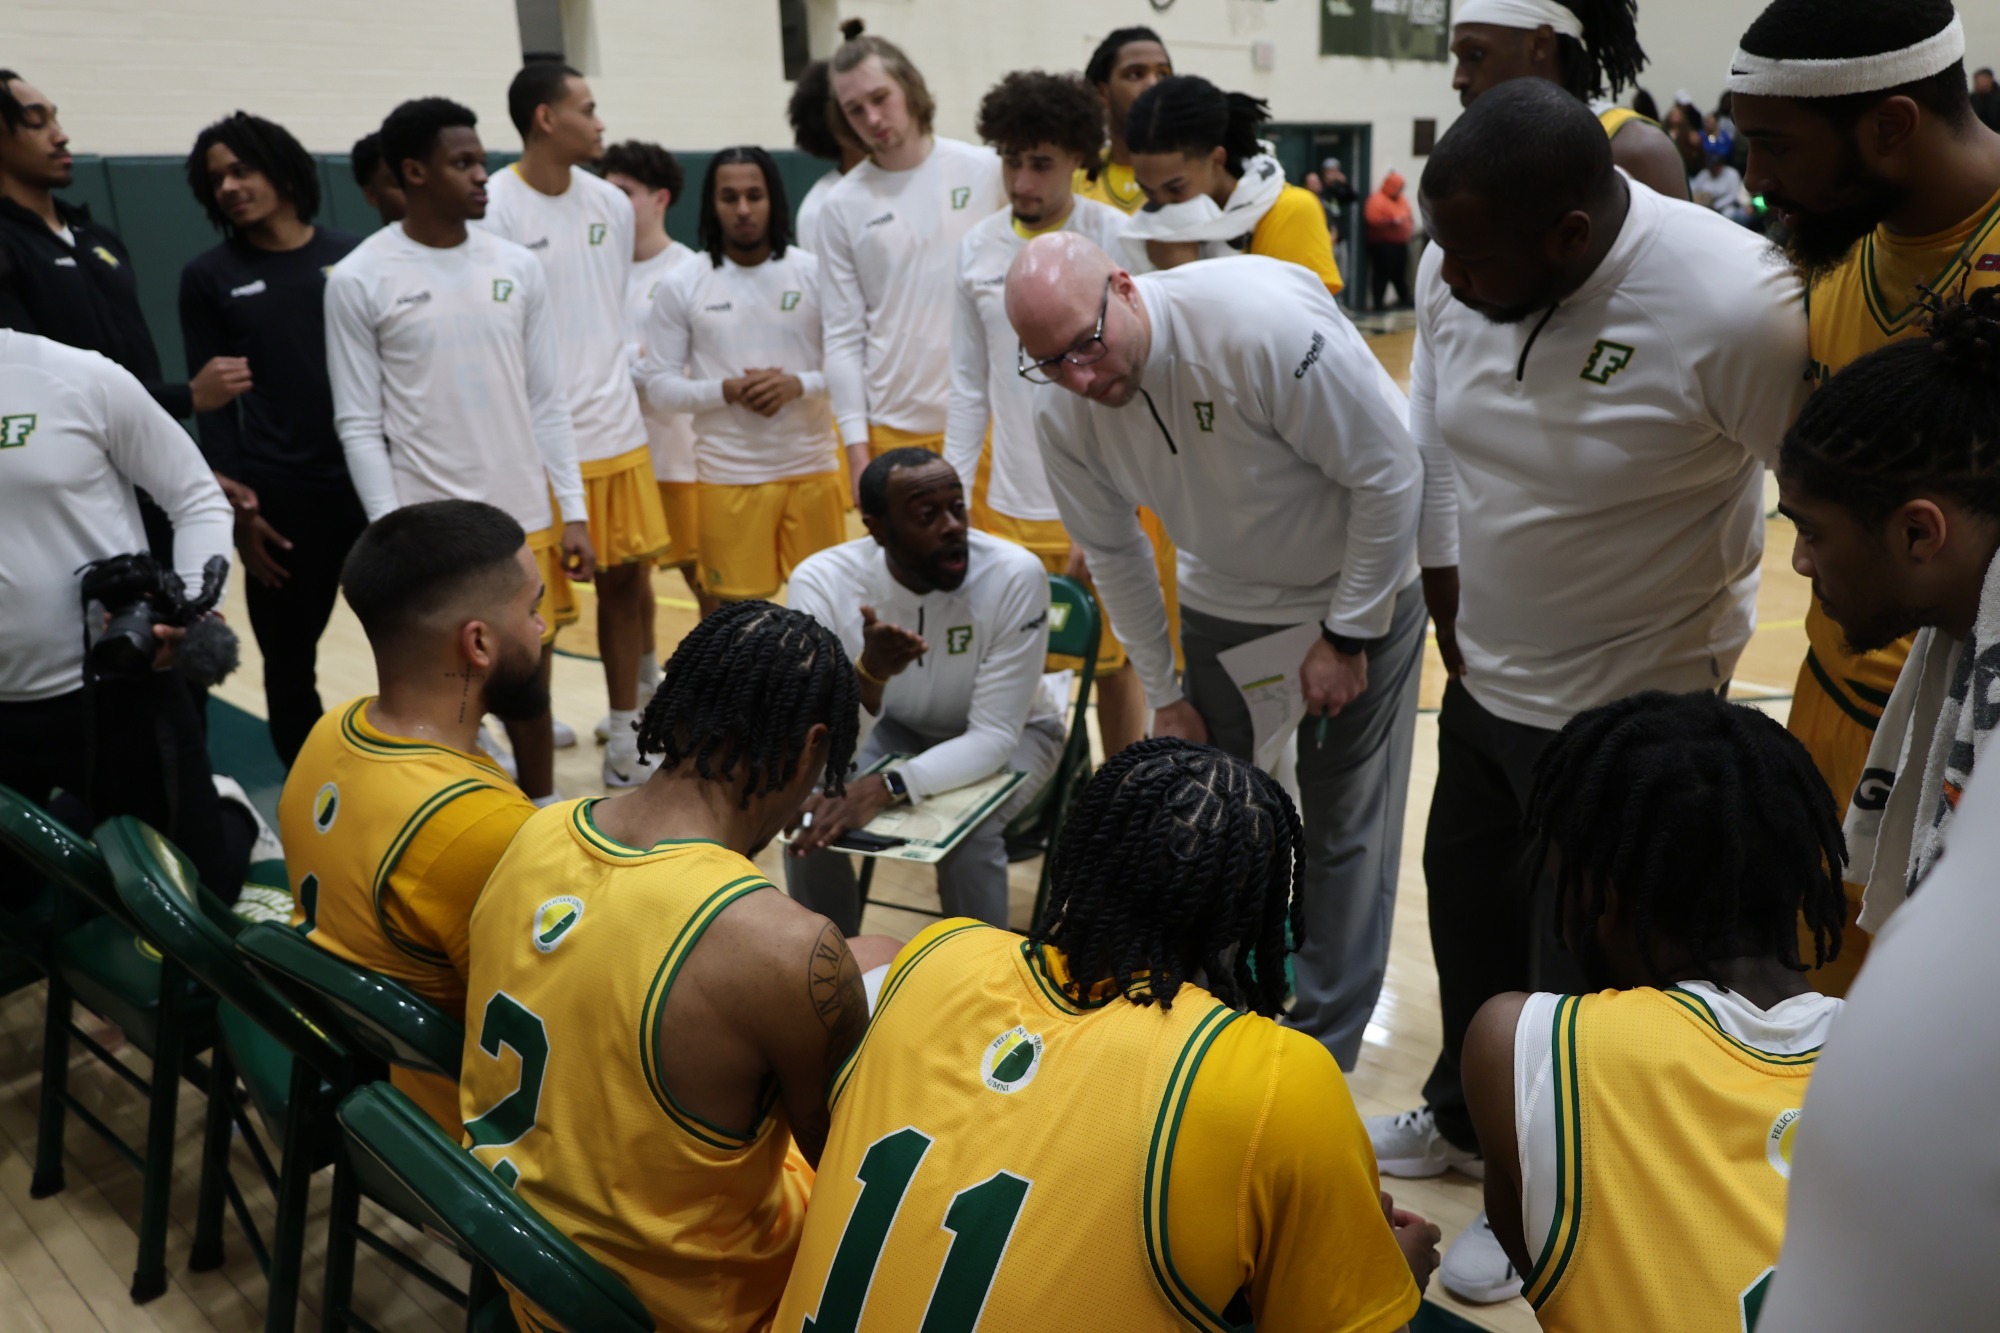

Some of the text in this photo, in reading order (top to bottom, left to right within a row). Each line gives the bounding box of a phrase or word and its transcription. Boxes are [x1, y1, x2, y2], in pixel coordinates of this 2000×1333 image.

[1294, 330, 1326, 379] capelli
[1579, 340, 1635, 385] F
[0, 414, 37, 448] F
[948, 626, 973, 654] F
[463, 990, 550, 1190] 2
[801, 1125, 1034, 1333] 11
